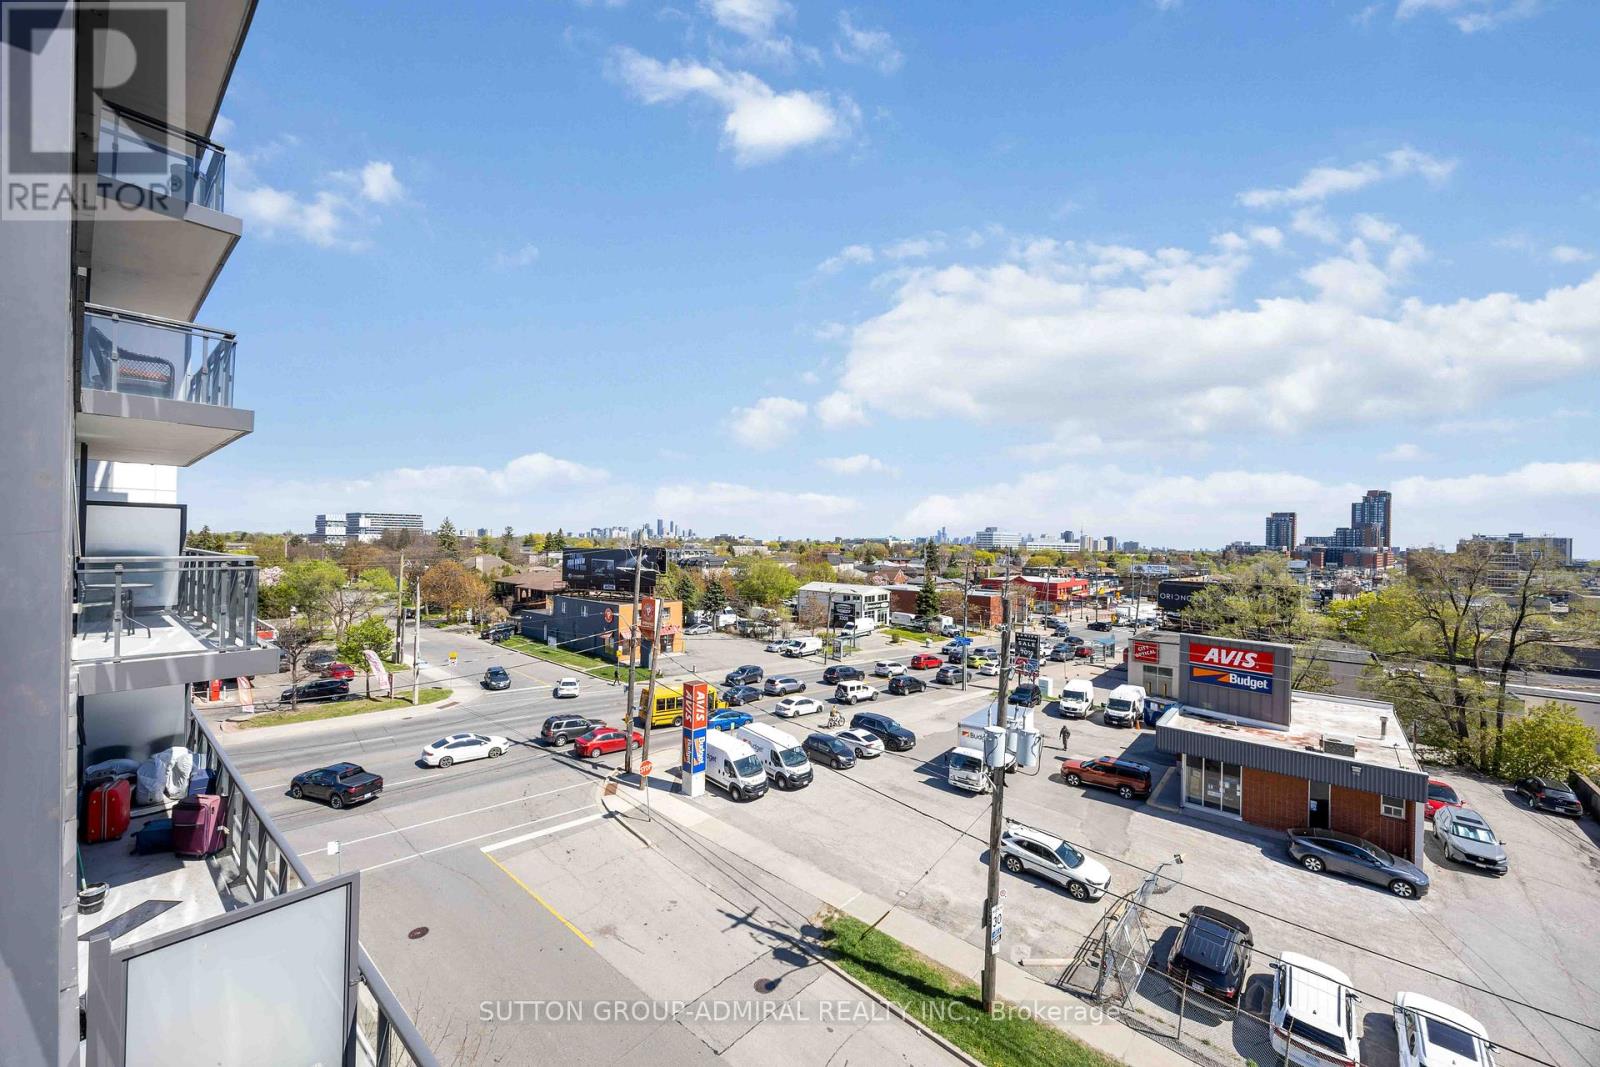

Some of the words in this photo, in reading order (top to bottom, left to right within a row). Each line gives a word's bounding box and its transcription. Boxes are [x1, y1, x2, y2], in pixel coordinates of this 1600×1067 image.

[1203, 647, 1258, 668] AVIS
[1229, 673, 1268, 690] Budget
[685, 689, 693, 722] AVIS
[696, 691, 705, 722] AVIS
[993, 913, 1002, 927] 30
